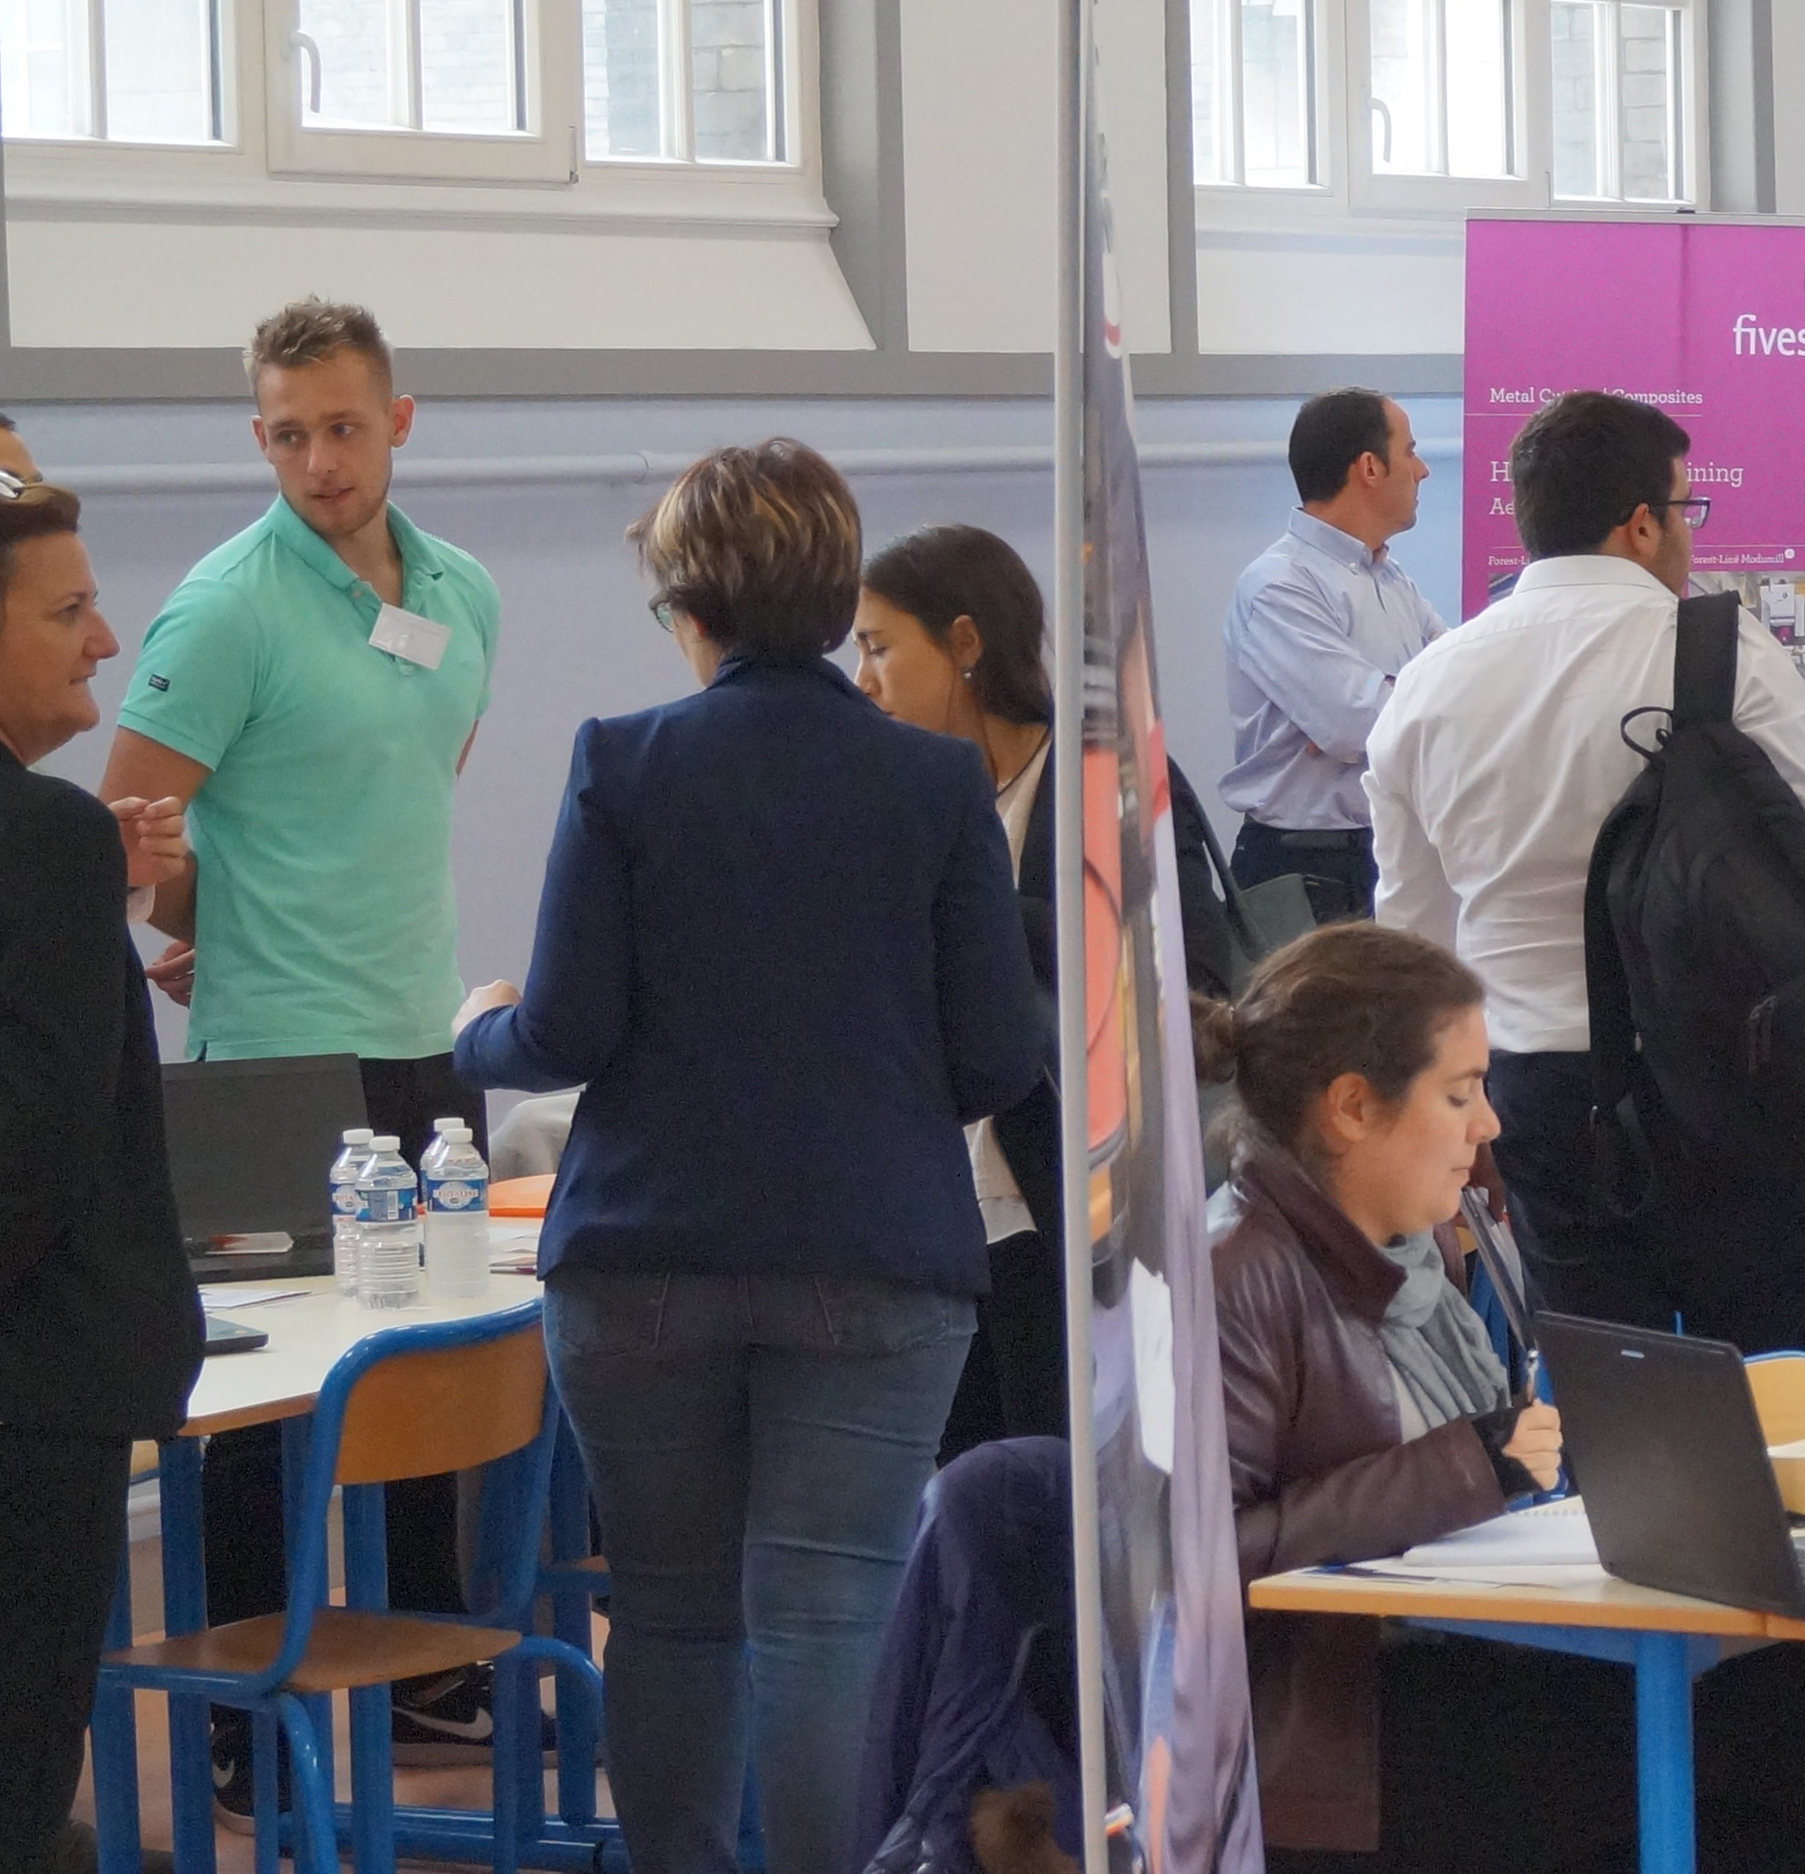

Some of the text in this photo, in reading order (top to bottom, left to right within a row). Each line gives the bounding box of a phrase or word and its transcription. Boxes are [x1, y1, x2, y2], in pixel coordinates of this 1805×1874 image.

[1489, 387, 1535, 404] Metal
[1687, 461, 1744, 487] ining
[1488, 555, 1527, 566] Forest-L
